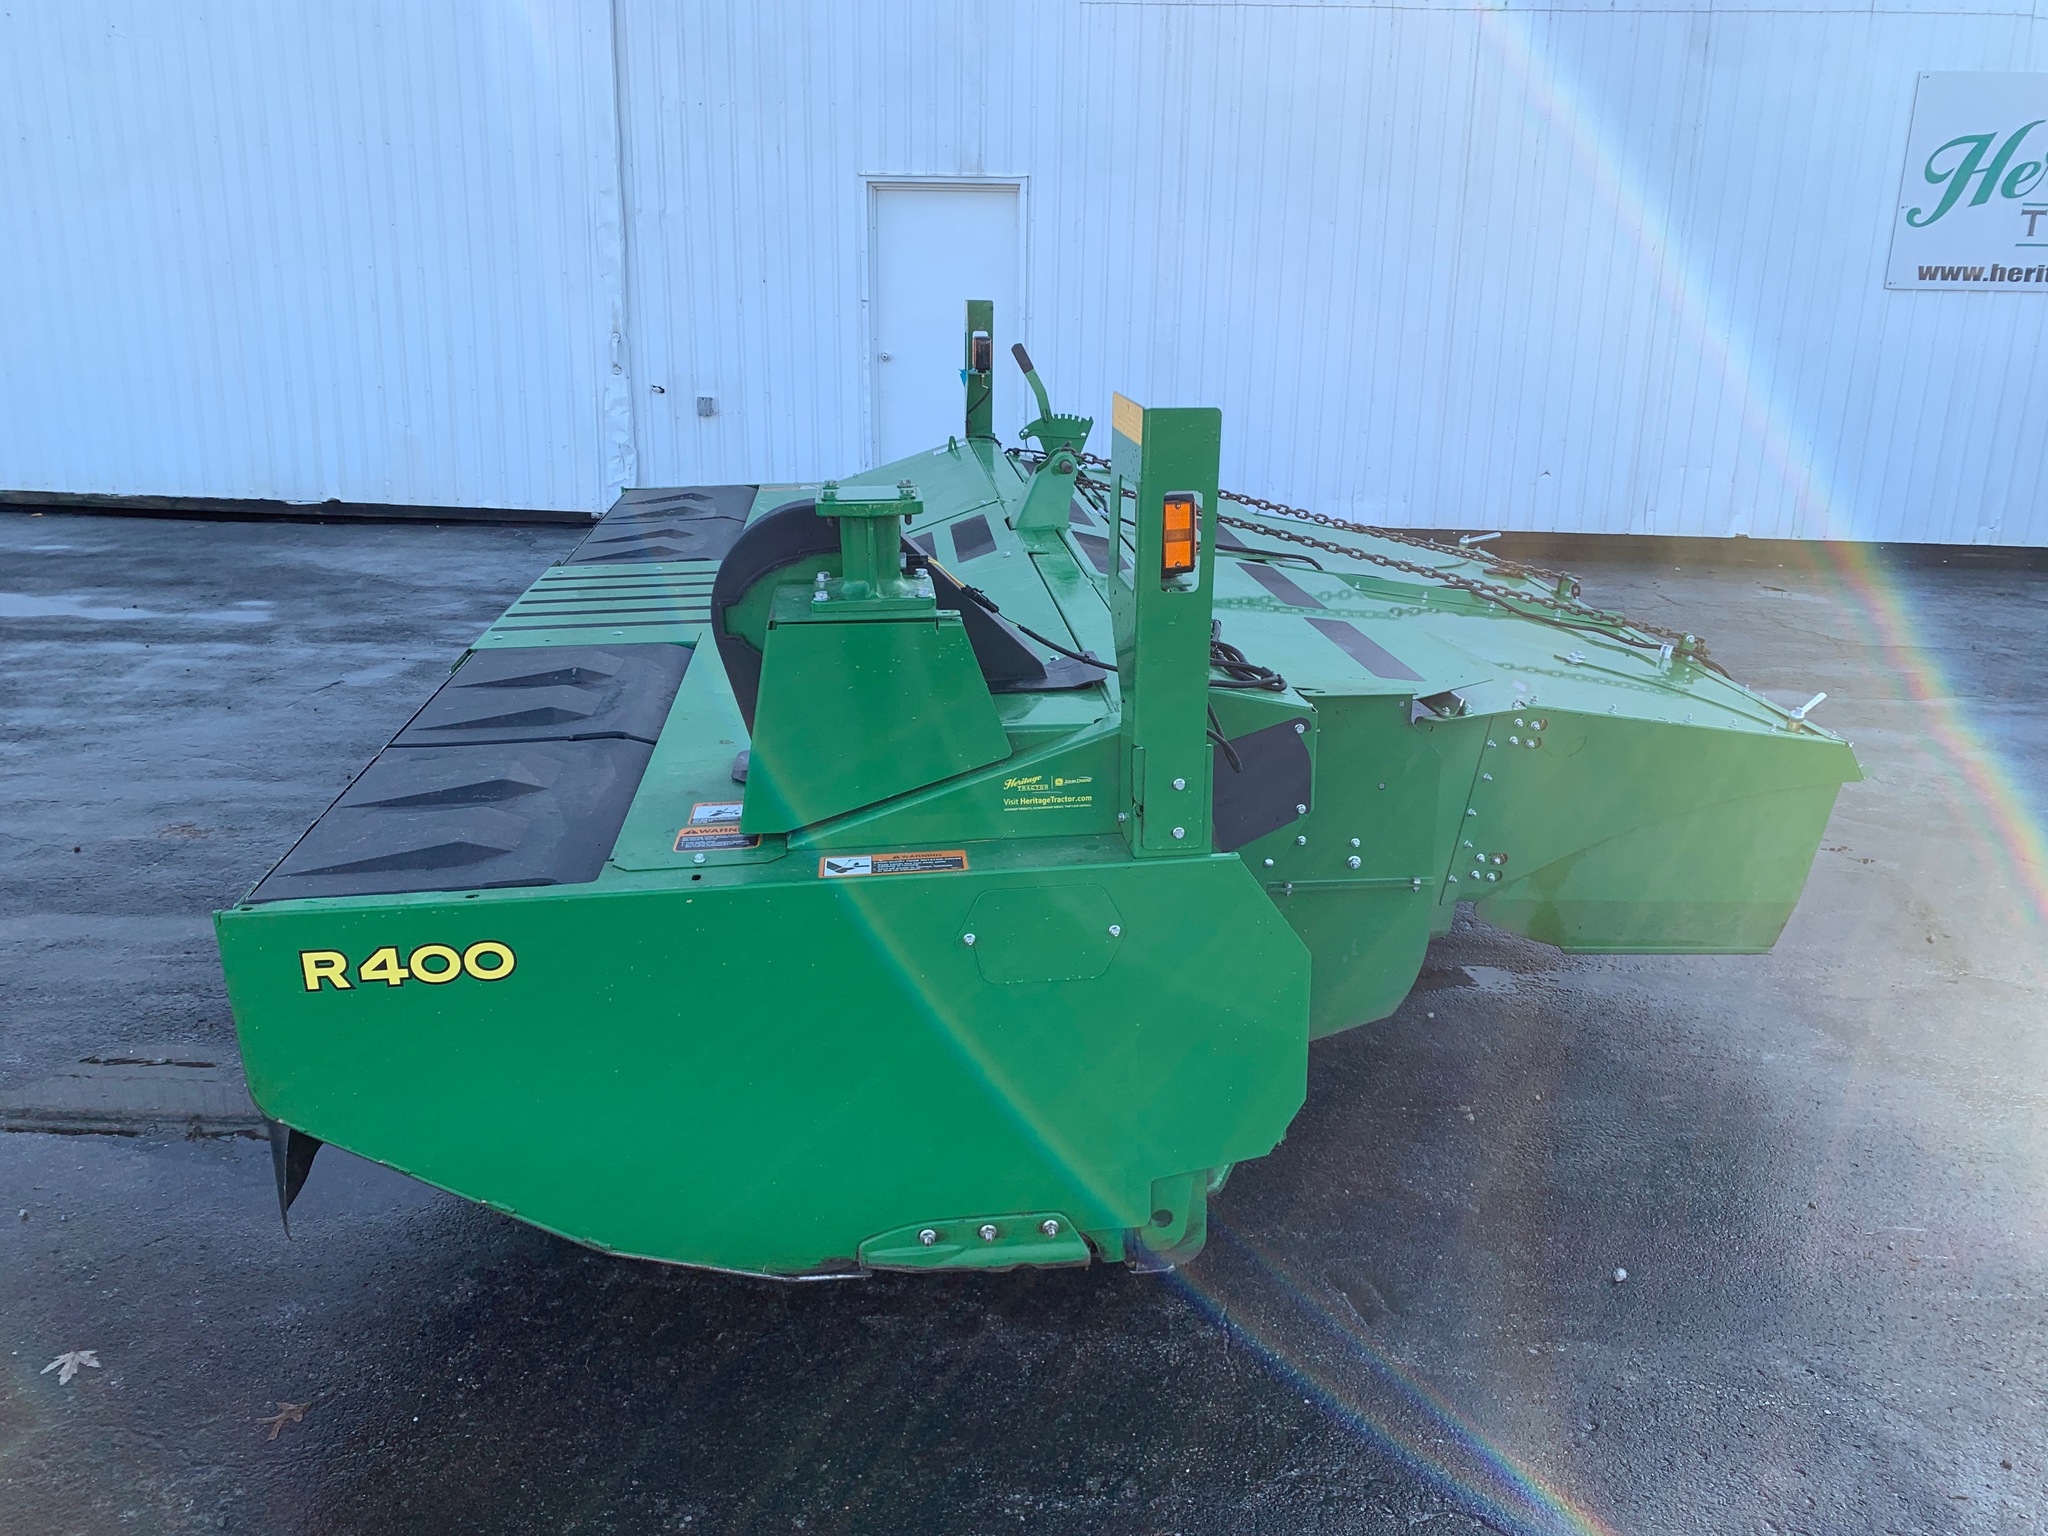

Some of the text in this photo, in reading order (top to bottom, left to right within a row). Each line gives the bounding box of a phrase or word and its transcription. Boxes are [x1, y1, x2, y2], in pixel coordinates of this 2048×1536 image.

[1906, 120, 2048, 227] He
[1004, 796, 1092, 806] Visit HeritageTractor.com
